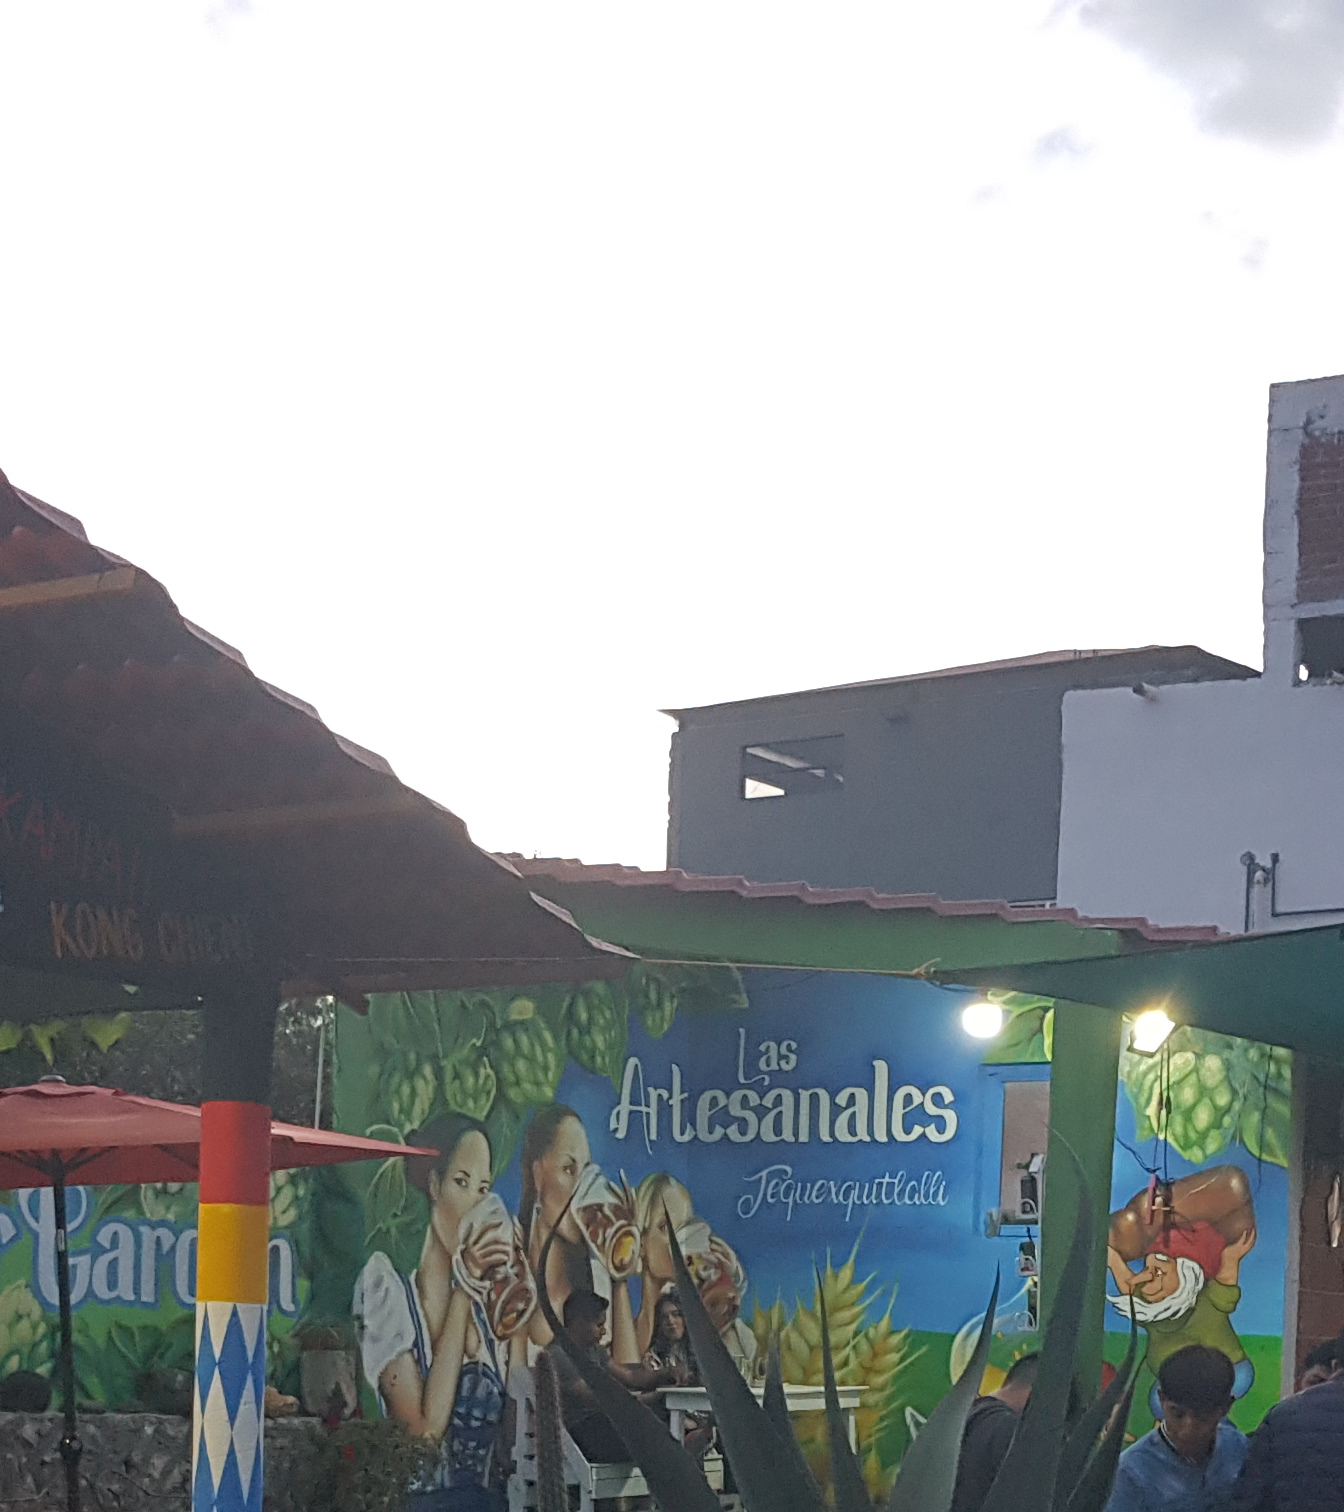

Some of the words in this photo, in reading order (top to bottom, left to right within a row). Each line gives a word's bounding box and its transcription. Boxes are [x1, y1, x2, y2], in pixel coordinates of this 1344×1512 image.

[49, 900, 145, 963] KONG
[737, 1027, 799, 1086] Las
[609, 1056, 959, 1155] Artesanales
